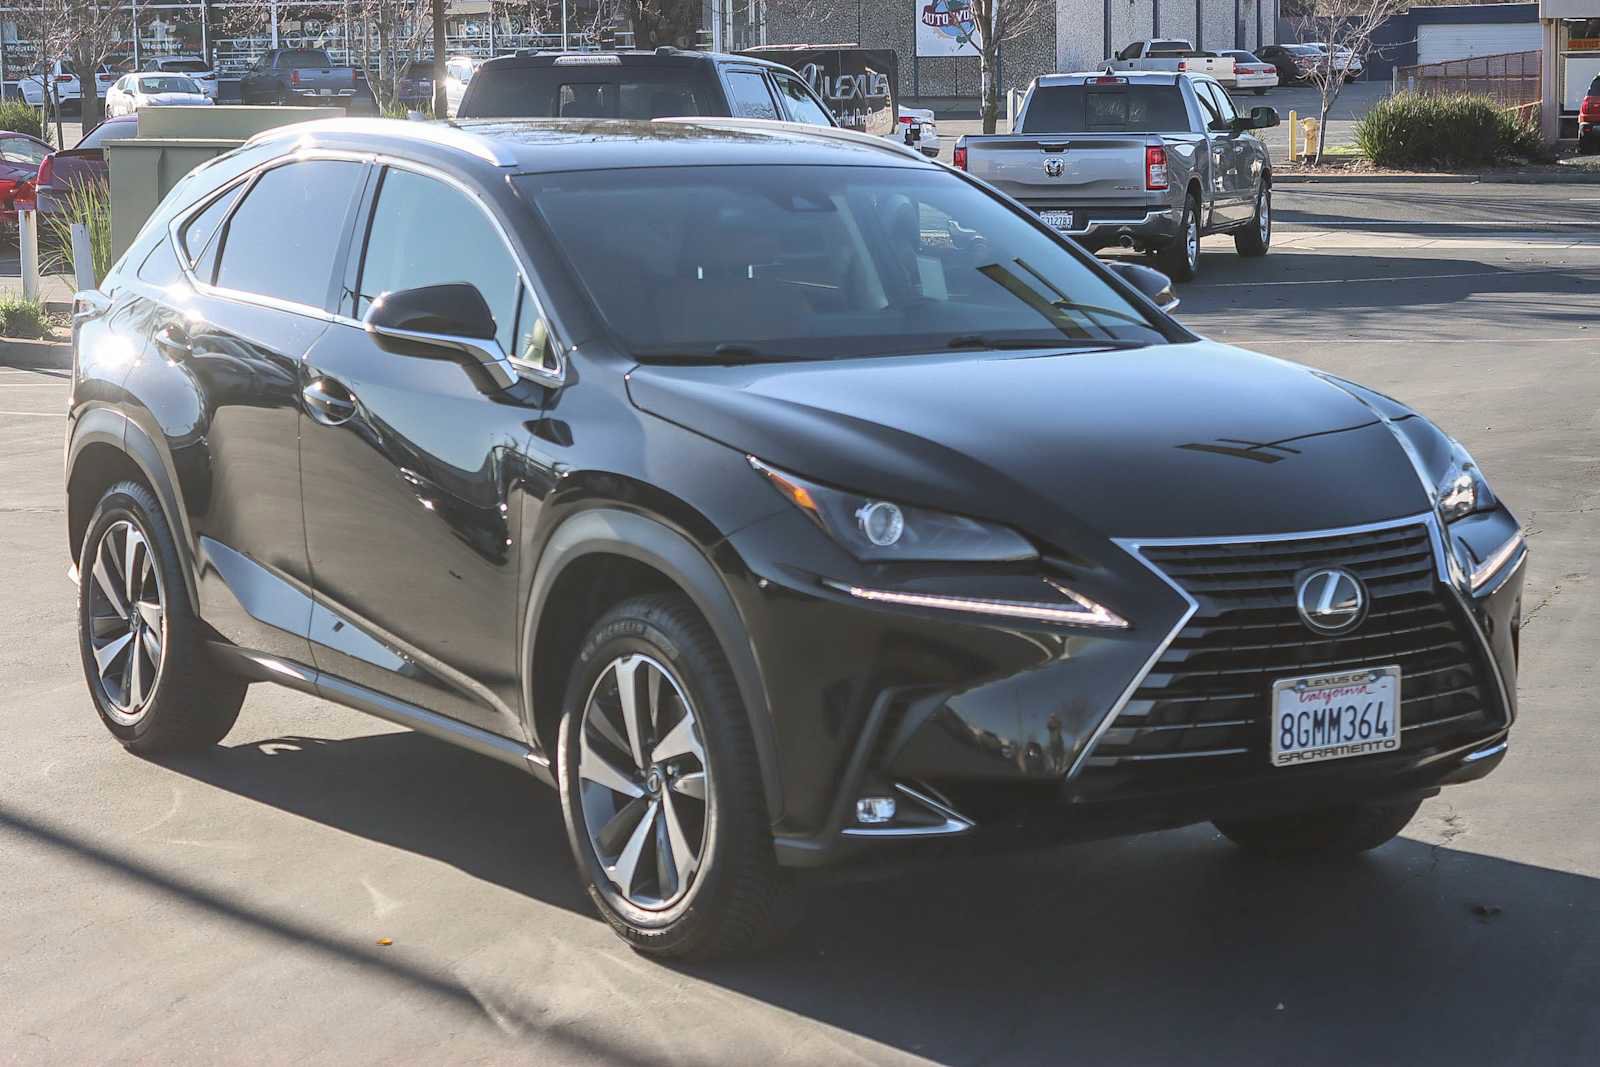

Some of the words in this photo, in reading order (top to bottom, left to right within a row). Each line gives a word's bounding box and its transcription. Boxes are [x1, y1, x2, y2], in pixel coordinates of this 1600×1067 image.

[923, 12, 949, 26] AUTO
[1351, 673, 1369, 683] OF
[1300, 686, 1376, 705] California
[1280, 701, 1389, 750] 8GMM364
[1278, 739, 1396, 764] SACRAMENTO
